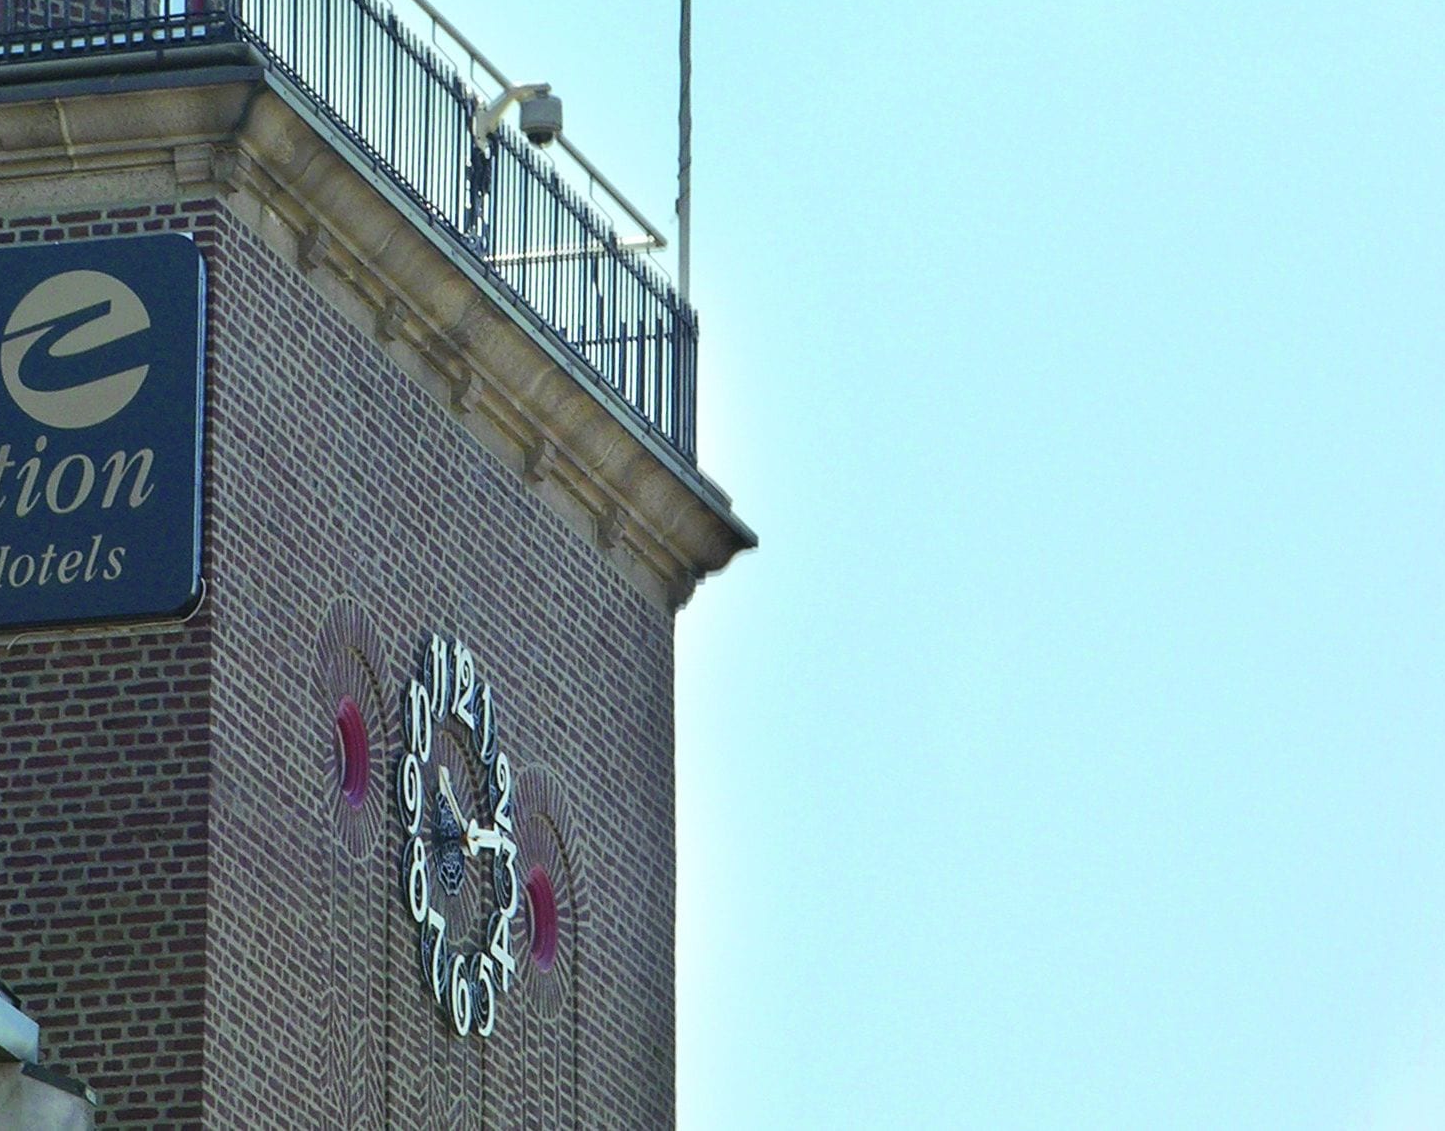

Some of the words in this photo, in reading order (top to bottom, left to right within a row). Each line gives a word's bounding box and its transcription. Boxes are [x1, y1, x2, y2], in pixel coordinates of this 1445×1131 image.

[431, 634, 448, 718] 11
[452, 639, 475, 731] 12
[411, 679, 432, 763] 10
[403, 753, 422, 835] 9
[494, 752, 512, 833] 2
[409, 836, 427, 922] 8
[428, 907, 447, 1003] 7
[478, 952, 495, 1037] 5
[491, 913, 515, 993] 4
[452, 955, 471, 1037] 6
